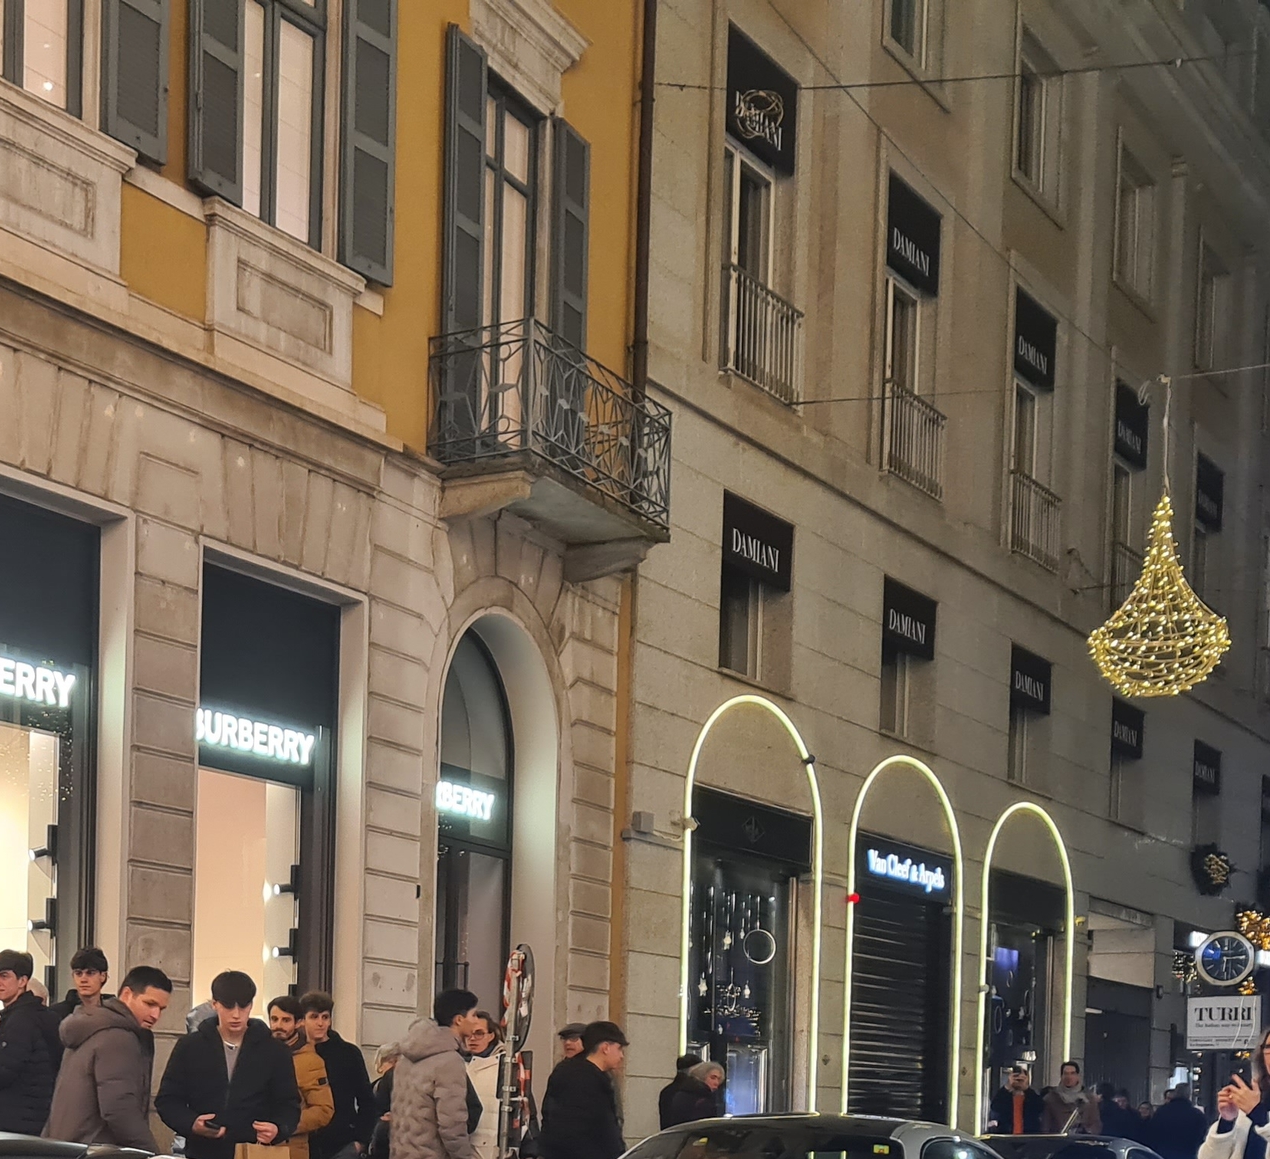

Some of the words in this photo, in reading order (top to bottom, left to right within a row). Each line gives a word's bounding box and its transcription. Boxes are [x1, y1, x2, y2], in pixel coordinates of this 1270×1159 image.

[893, 227, 930, 277] DAMIANI
[1018, 335, 1048, 375] DAMIANI
[732, 527, 780, 573] DAMIANI
[889, 608, 926, 645] DAMIANI
[1015, 670, 1044, 701] DAMIANI
[867, 849, 887, 876] Van
[887, 853, 912, 881] Cleef
[918, 862, 945, 893] Arpels
[1194, 1006, 1253, 1022] TURRI
